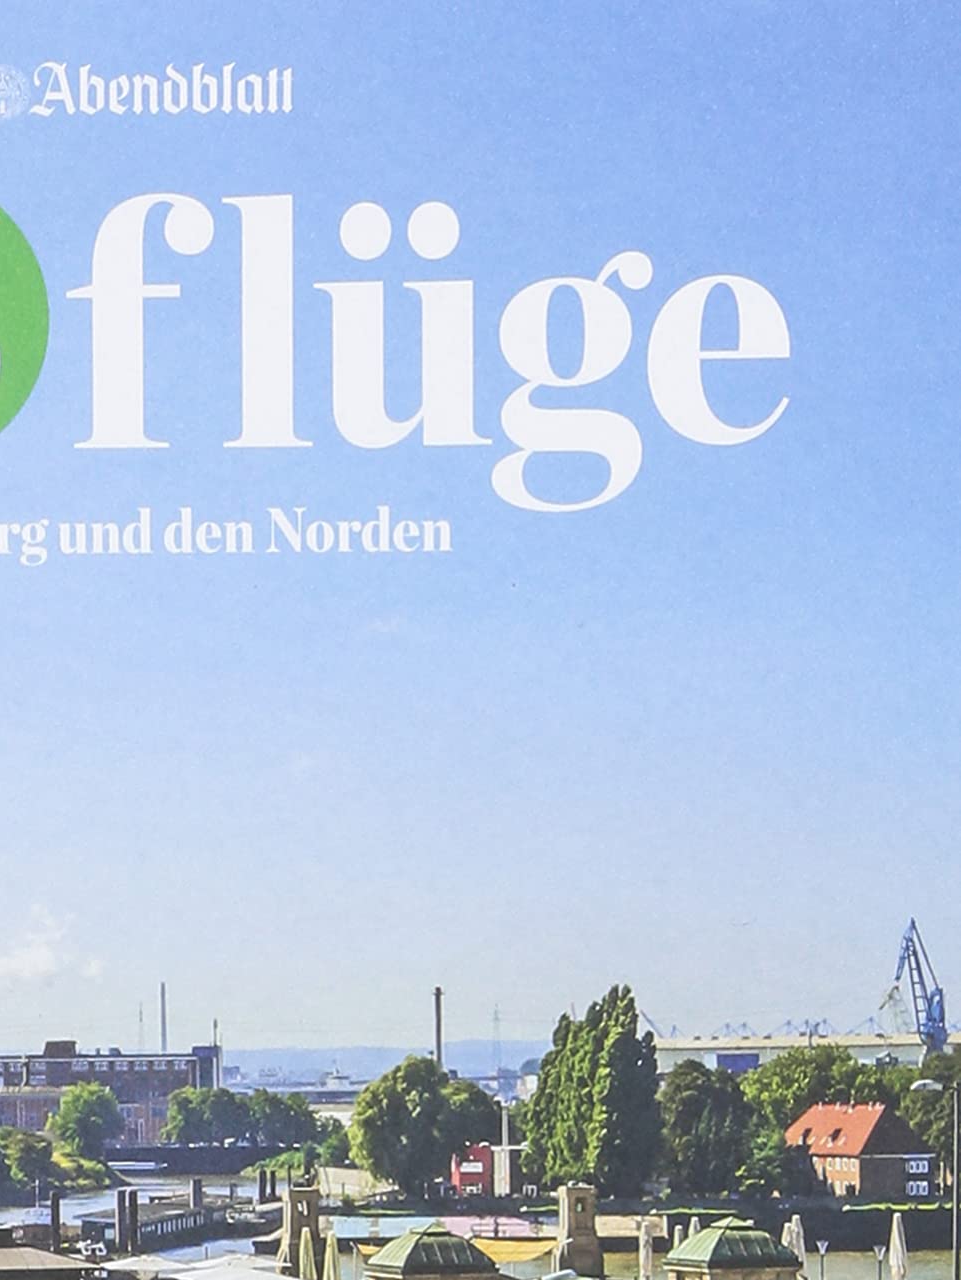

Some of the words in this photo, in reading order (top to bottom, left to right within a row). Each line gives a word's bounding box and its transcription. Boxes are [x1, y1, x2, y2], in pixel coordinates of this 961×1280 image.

[29, 61, 294, 117] Abendblatt
[59, 507, 153, 554] und
[164, 507, 255, 554] den
[266, 505, 453, 553] Norden
